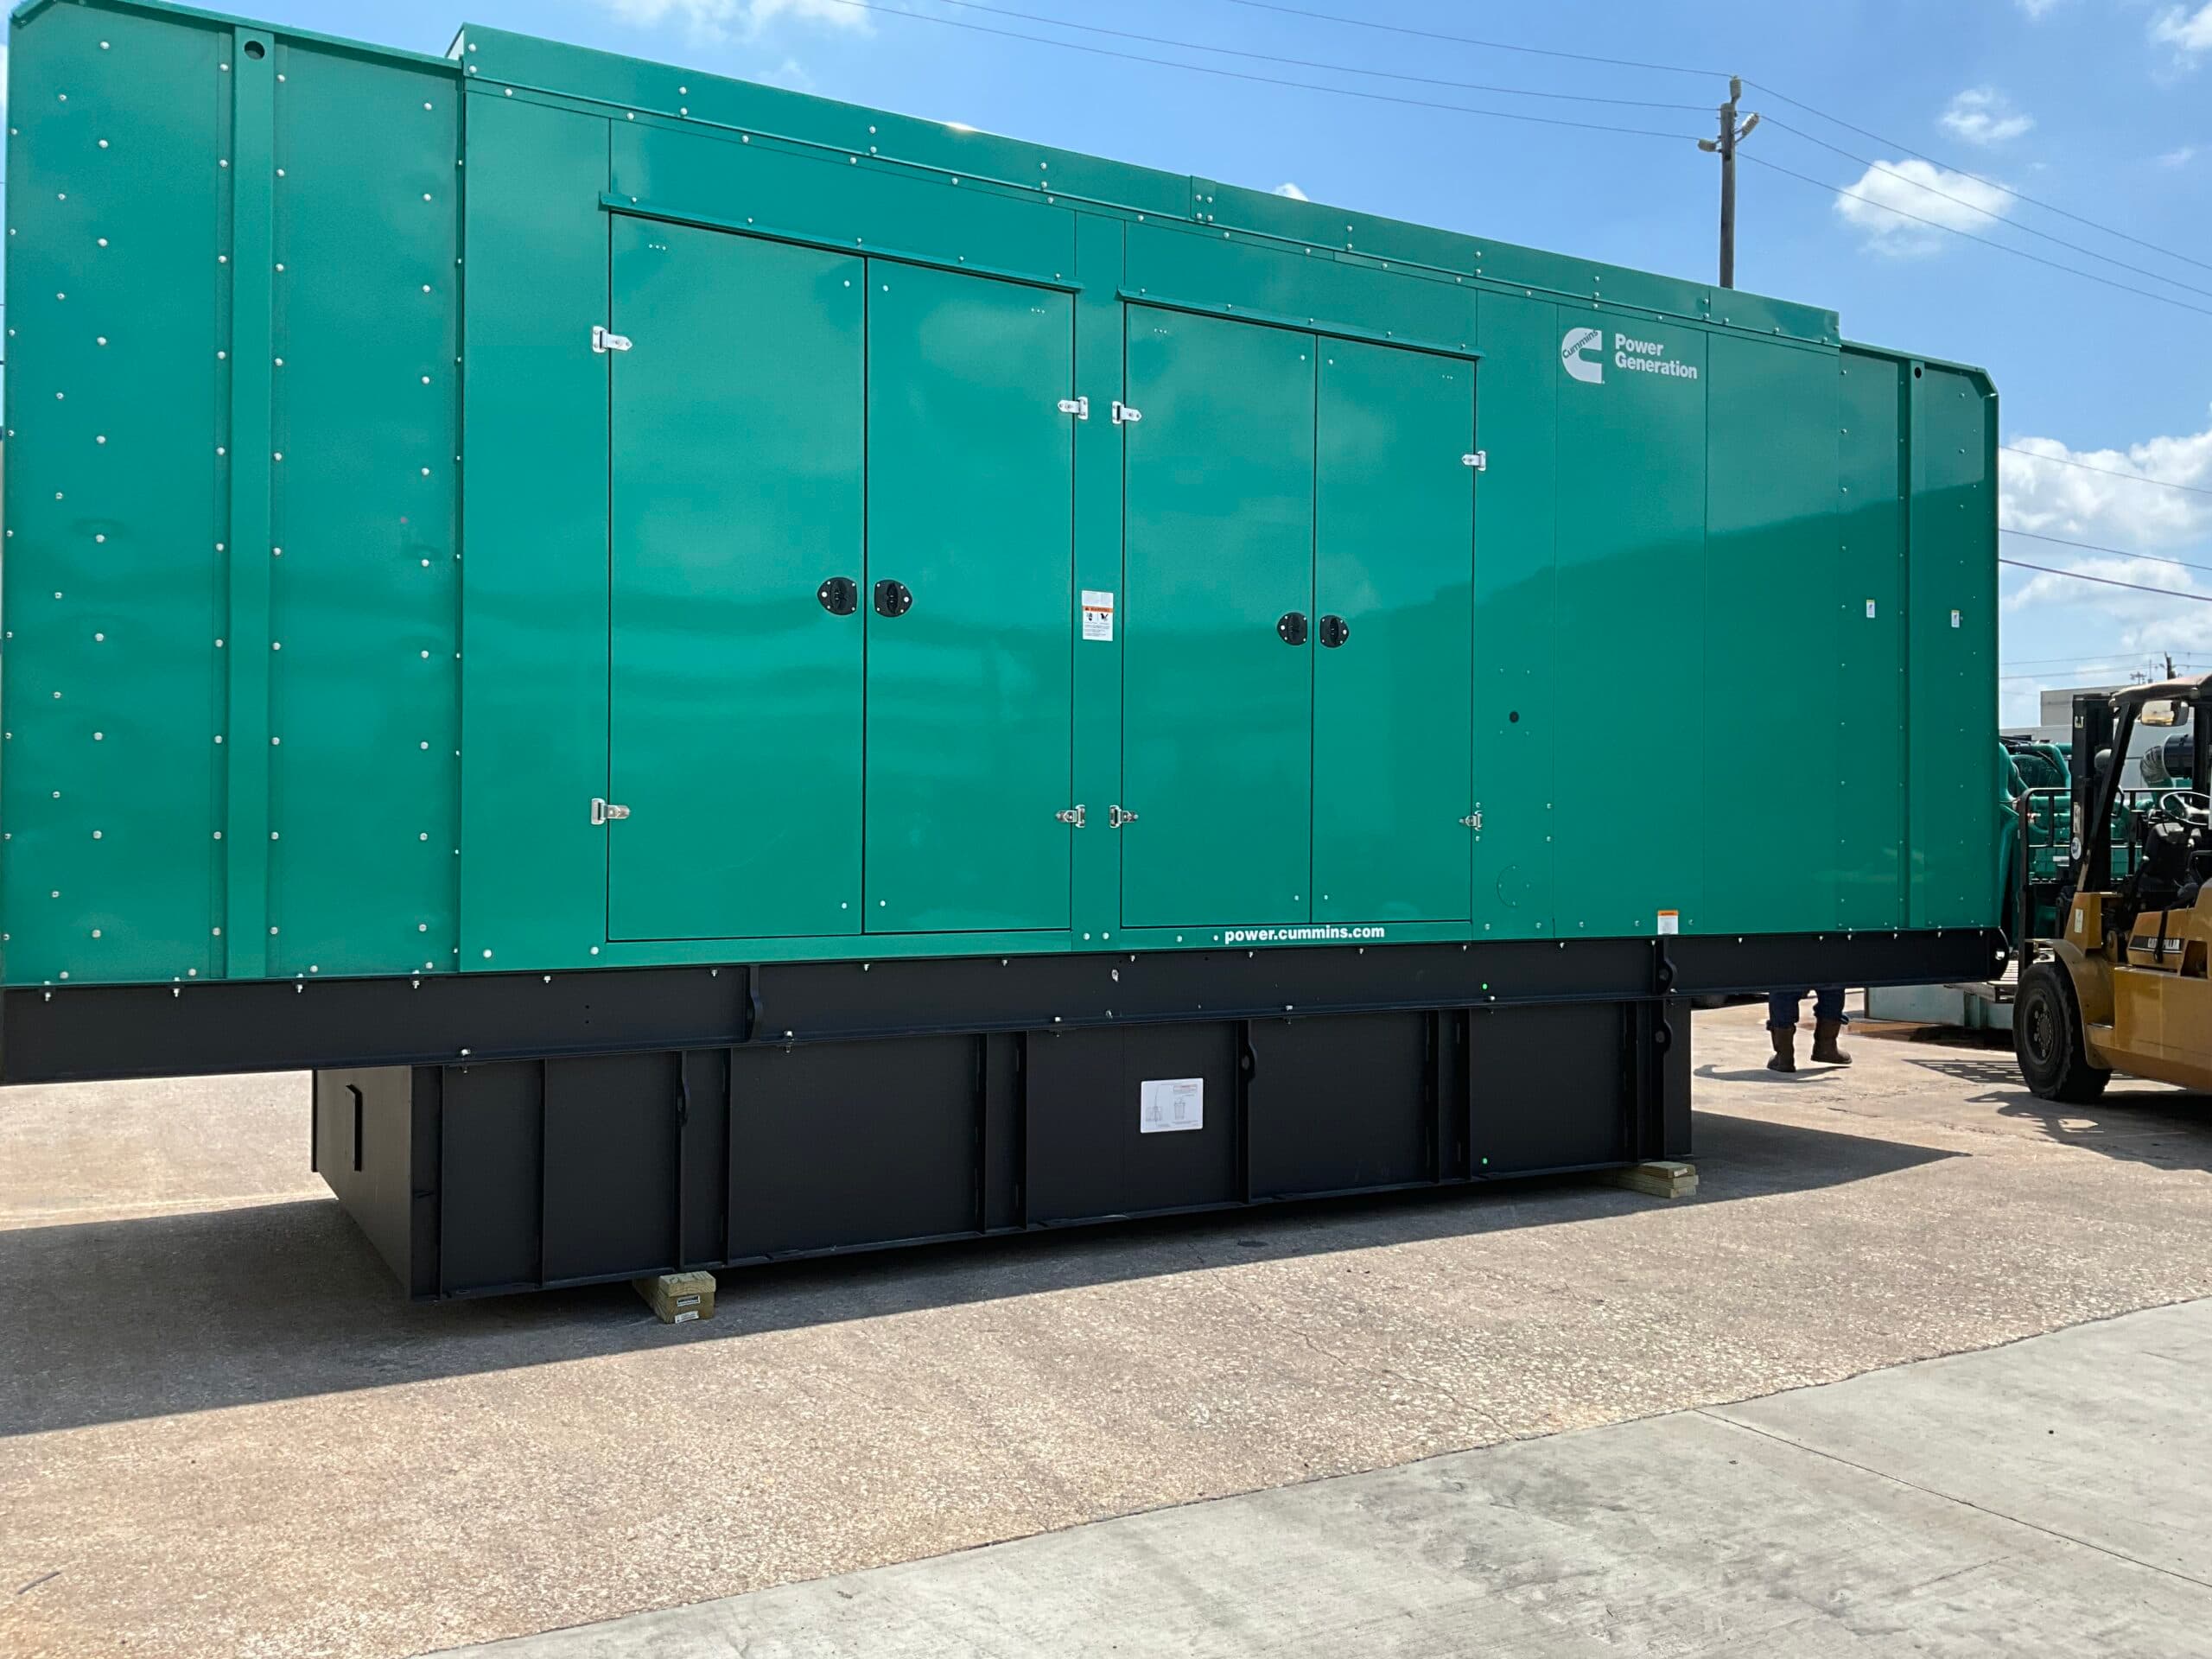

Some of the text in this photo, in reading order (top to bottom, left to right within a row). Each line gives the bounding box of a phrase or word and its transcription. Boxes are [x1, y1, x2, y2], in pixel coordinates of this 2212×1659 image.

[1562, 330, 1598, 359] Cummins
[1615, 333, 1664, 357] Power
[1615, 352, 1698, 379] Generation
[1224, 925, 1384, 944] power.cummins.com
